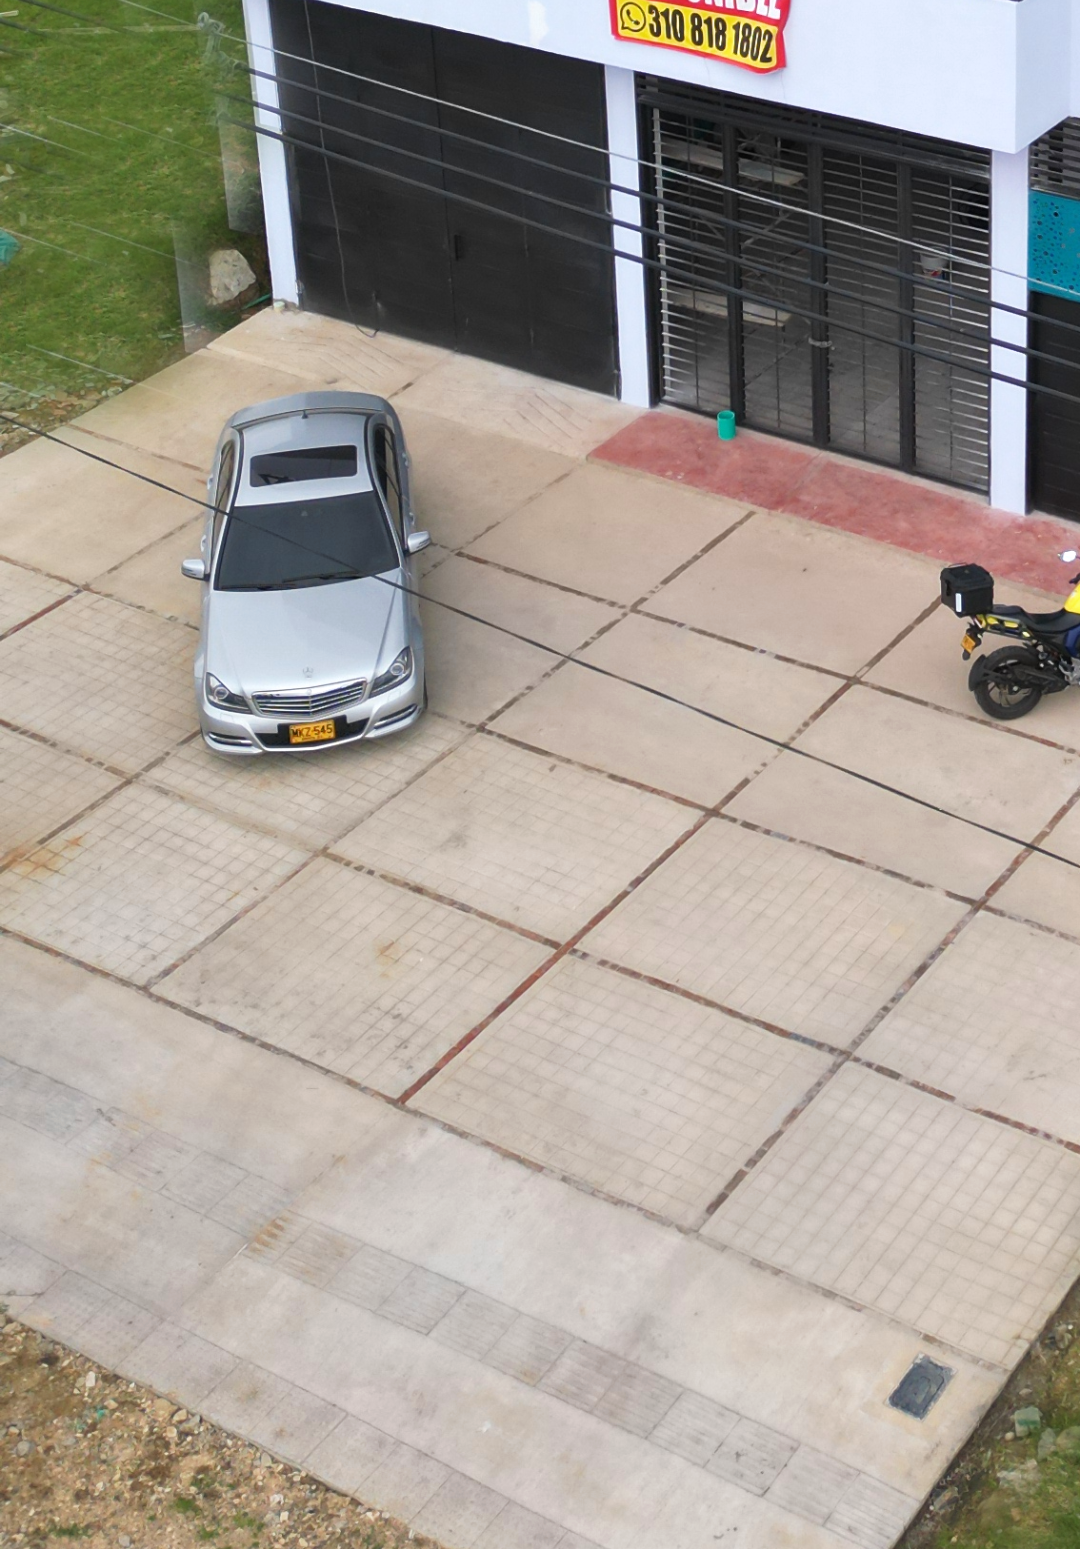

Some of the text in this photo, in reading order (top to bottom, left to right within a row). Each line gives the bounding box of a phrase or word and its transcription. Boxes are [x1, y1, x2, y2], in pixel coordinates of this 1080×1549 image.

[648, 4, 773, 63] 310 818 1802
